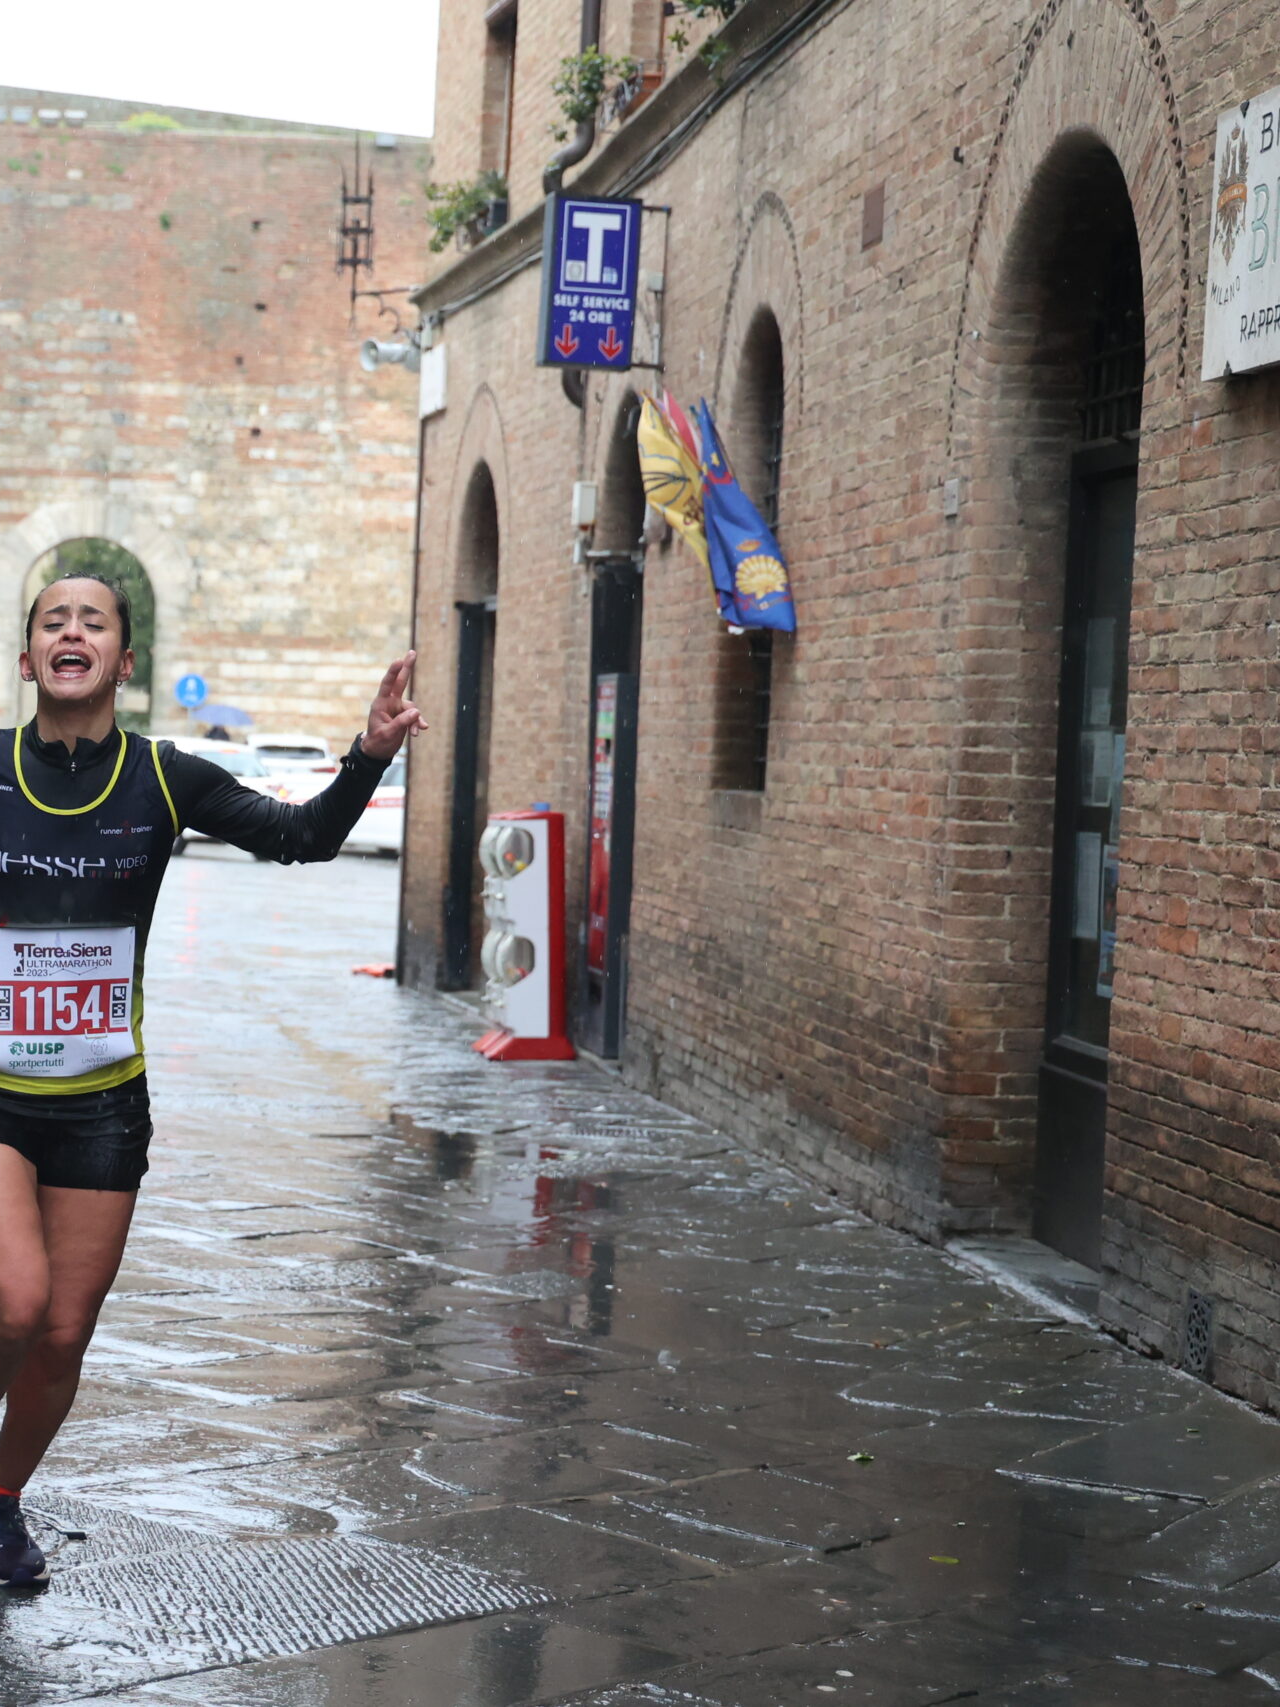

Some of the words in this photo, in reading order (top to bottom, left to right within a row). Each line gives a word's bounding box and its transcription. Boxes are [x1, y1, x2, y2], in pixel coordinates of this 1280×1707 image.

[573, 211, 621, 283] T
[1210, 274, 1241, 307] MILANO
[554, 294, 579, 306] SELF
[583, 296, 630, 311] SERVICE
[569, 309, 586, 323] 24
[588, 311, 613, 324] ORE
[100, 827, 124, 837] runner
[131, 825, 153, 835] trainer
[115, 854, 148, 869] VIDEO
[26, 958, 113, 969] ULTRAMARATHON
[26, 968, 49, 977] 2023
[20, 985, 103, 1031] 1154
[25, 1042, 65, 1056] UISP
[8, 1057, 65, 1069] sportpertutti
